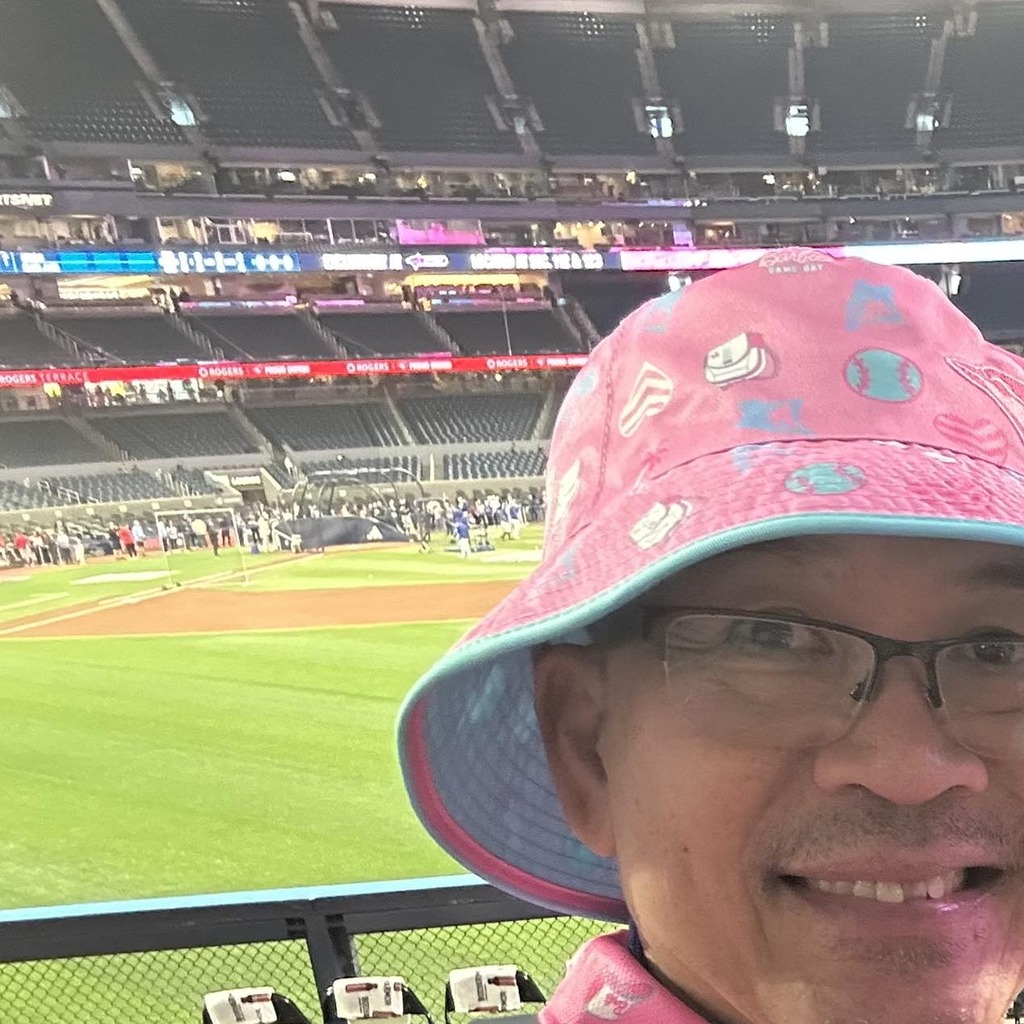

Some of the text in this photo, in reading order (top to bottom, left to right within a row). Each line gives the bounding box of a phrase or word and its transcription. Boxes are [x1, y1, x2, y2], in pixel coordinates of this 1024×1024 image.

[357, 362, 390, 372] ROGERS
[496, 358, 528, 368] ROGERS
[209, 365, 244, 376] ROGERS
[0, 371, 88, 384] ROGERS TERRACE
